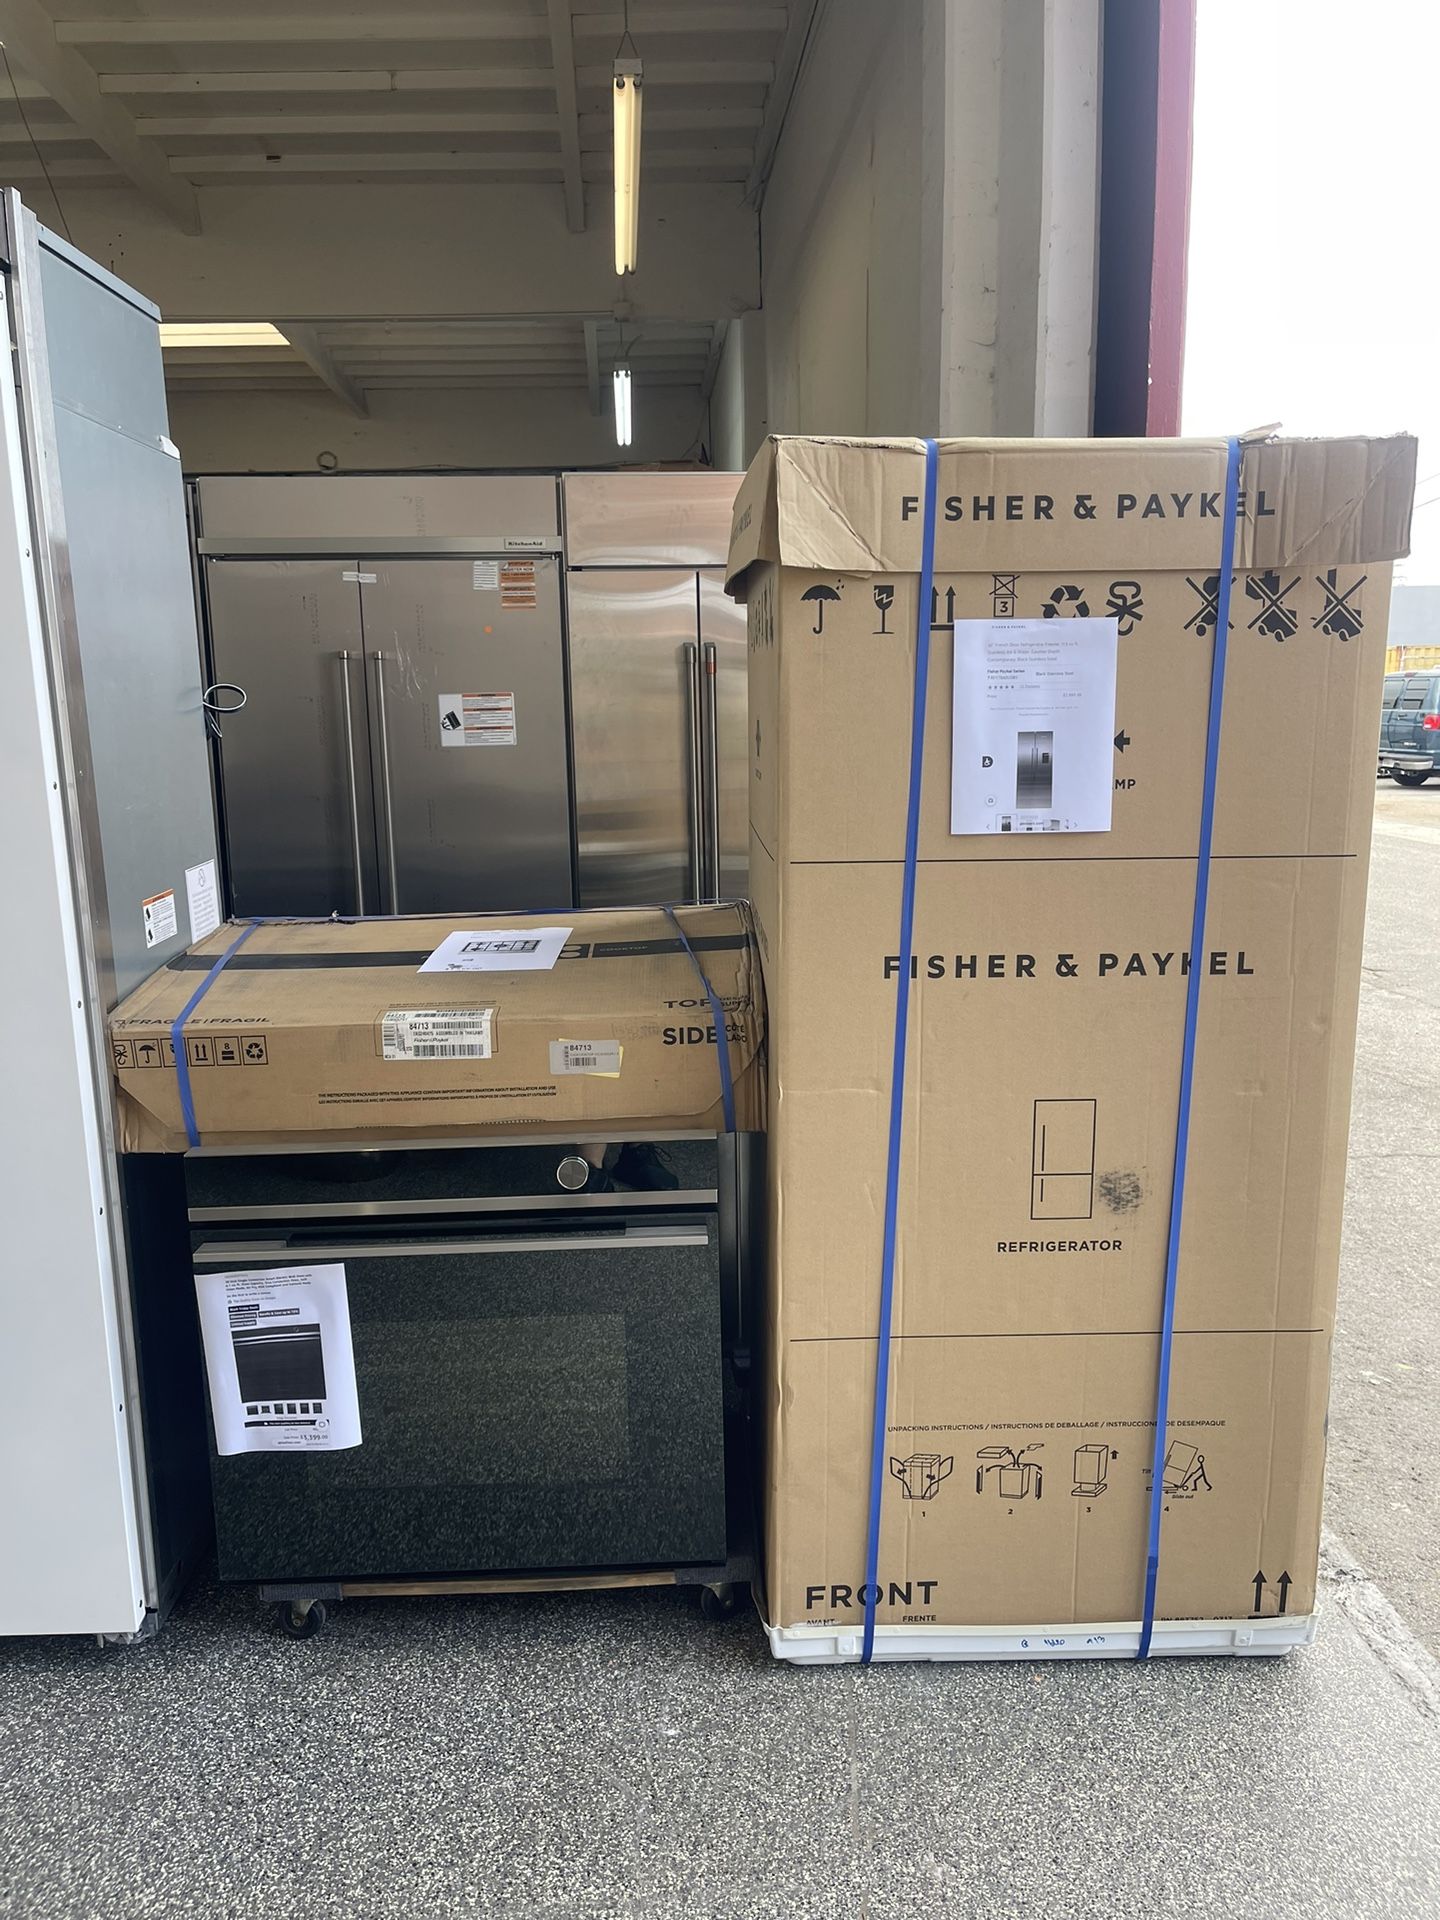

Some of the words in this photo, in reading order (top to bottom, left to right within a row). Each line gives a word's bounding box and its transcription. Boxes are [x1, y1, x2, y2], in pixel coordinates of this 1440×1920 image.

[901, 494, 1054, 521] FSHER
[1073, 494, 1097, 519] &
[999, 600, 1009, 614] 3
[884, 955, 1036, 979] FISHER
[1055, 953, 1079, 977] &
[662, 1025, 717, 1046] SIDE
[997, 1240, 1123, 1253] REFRIGERATOR
[806, 1581, 938, 1609] FRONT
[902, 1614, 937, 1622] FRENTE
